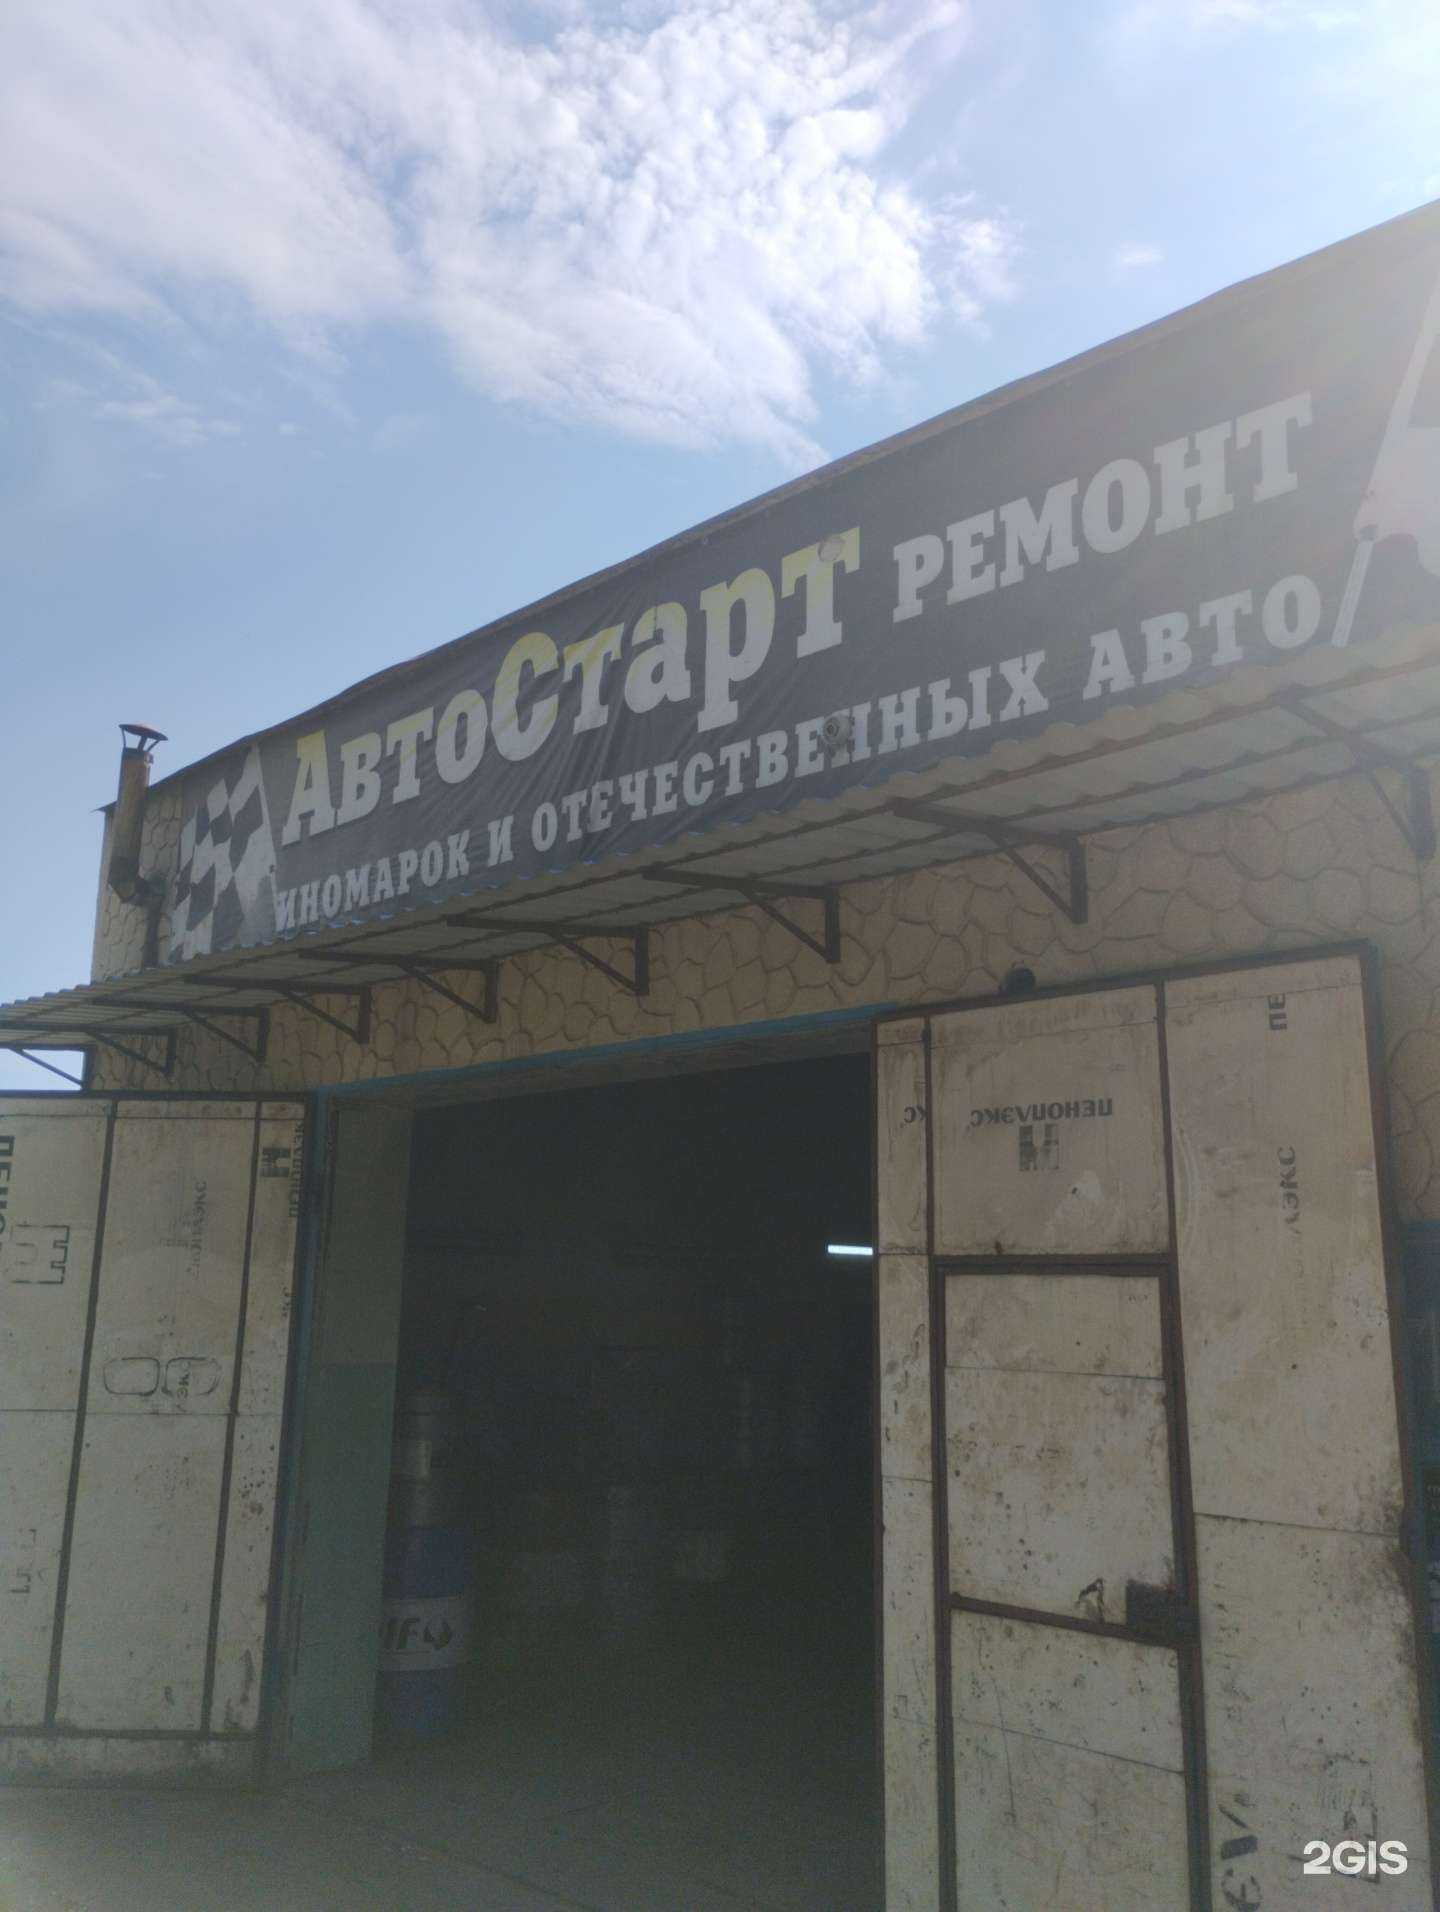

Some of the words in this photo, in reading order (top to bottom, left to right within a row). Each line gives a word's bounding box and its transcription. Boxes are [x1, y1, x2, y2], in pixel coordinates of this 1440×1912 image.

[892, 392, 1313, 623] РЕМОНТ
[276, 831, 470, 932] ИНОМАРОК
[488, 816, 514, 867] И
[531, 650, 1049, 852] ОТЕЧЕСТВЕННЫХ
[1083, 575, 1322, 700] АВТО
[970, 1098, 1113, 1125] ПЕНОПЛЭКС
